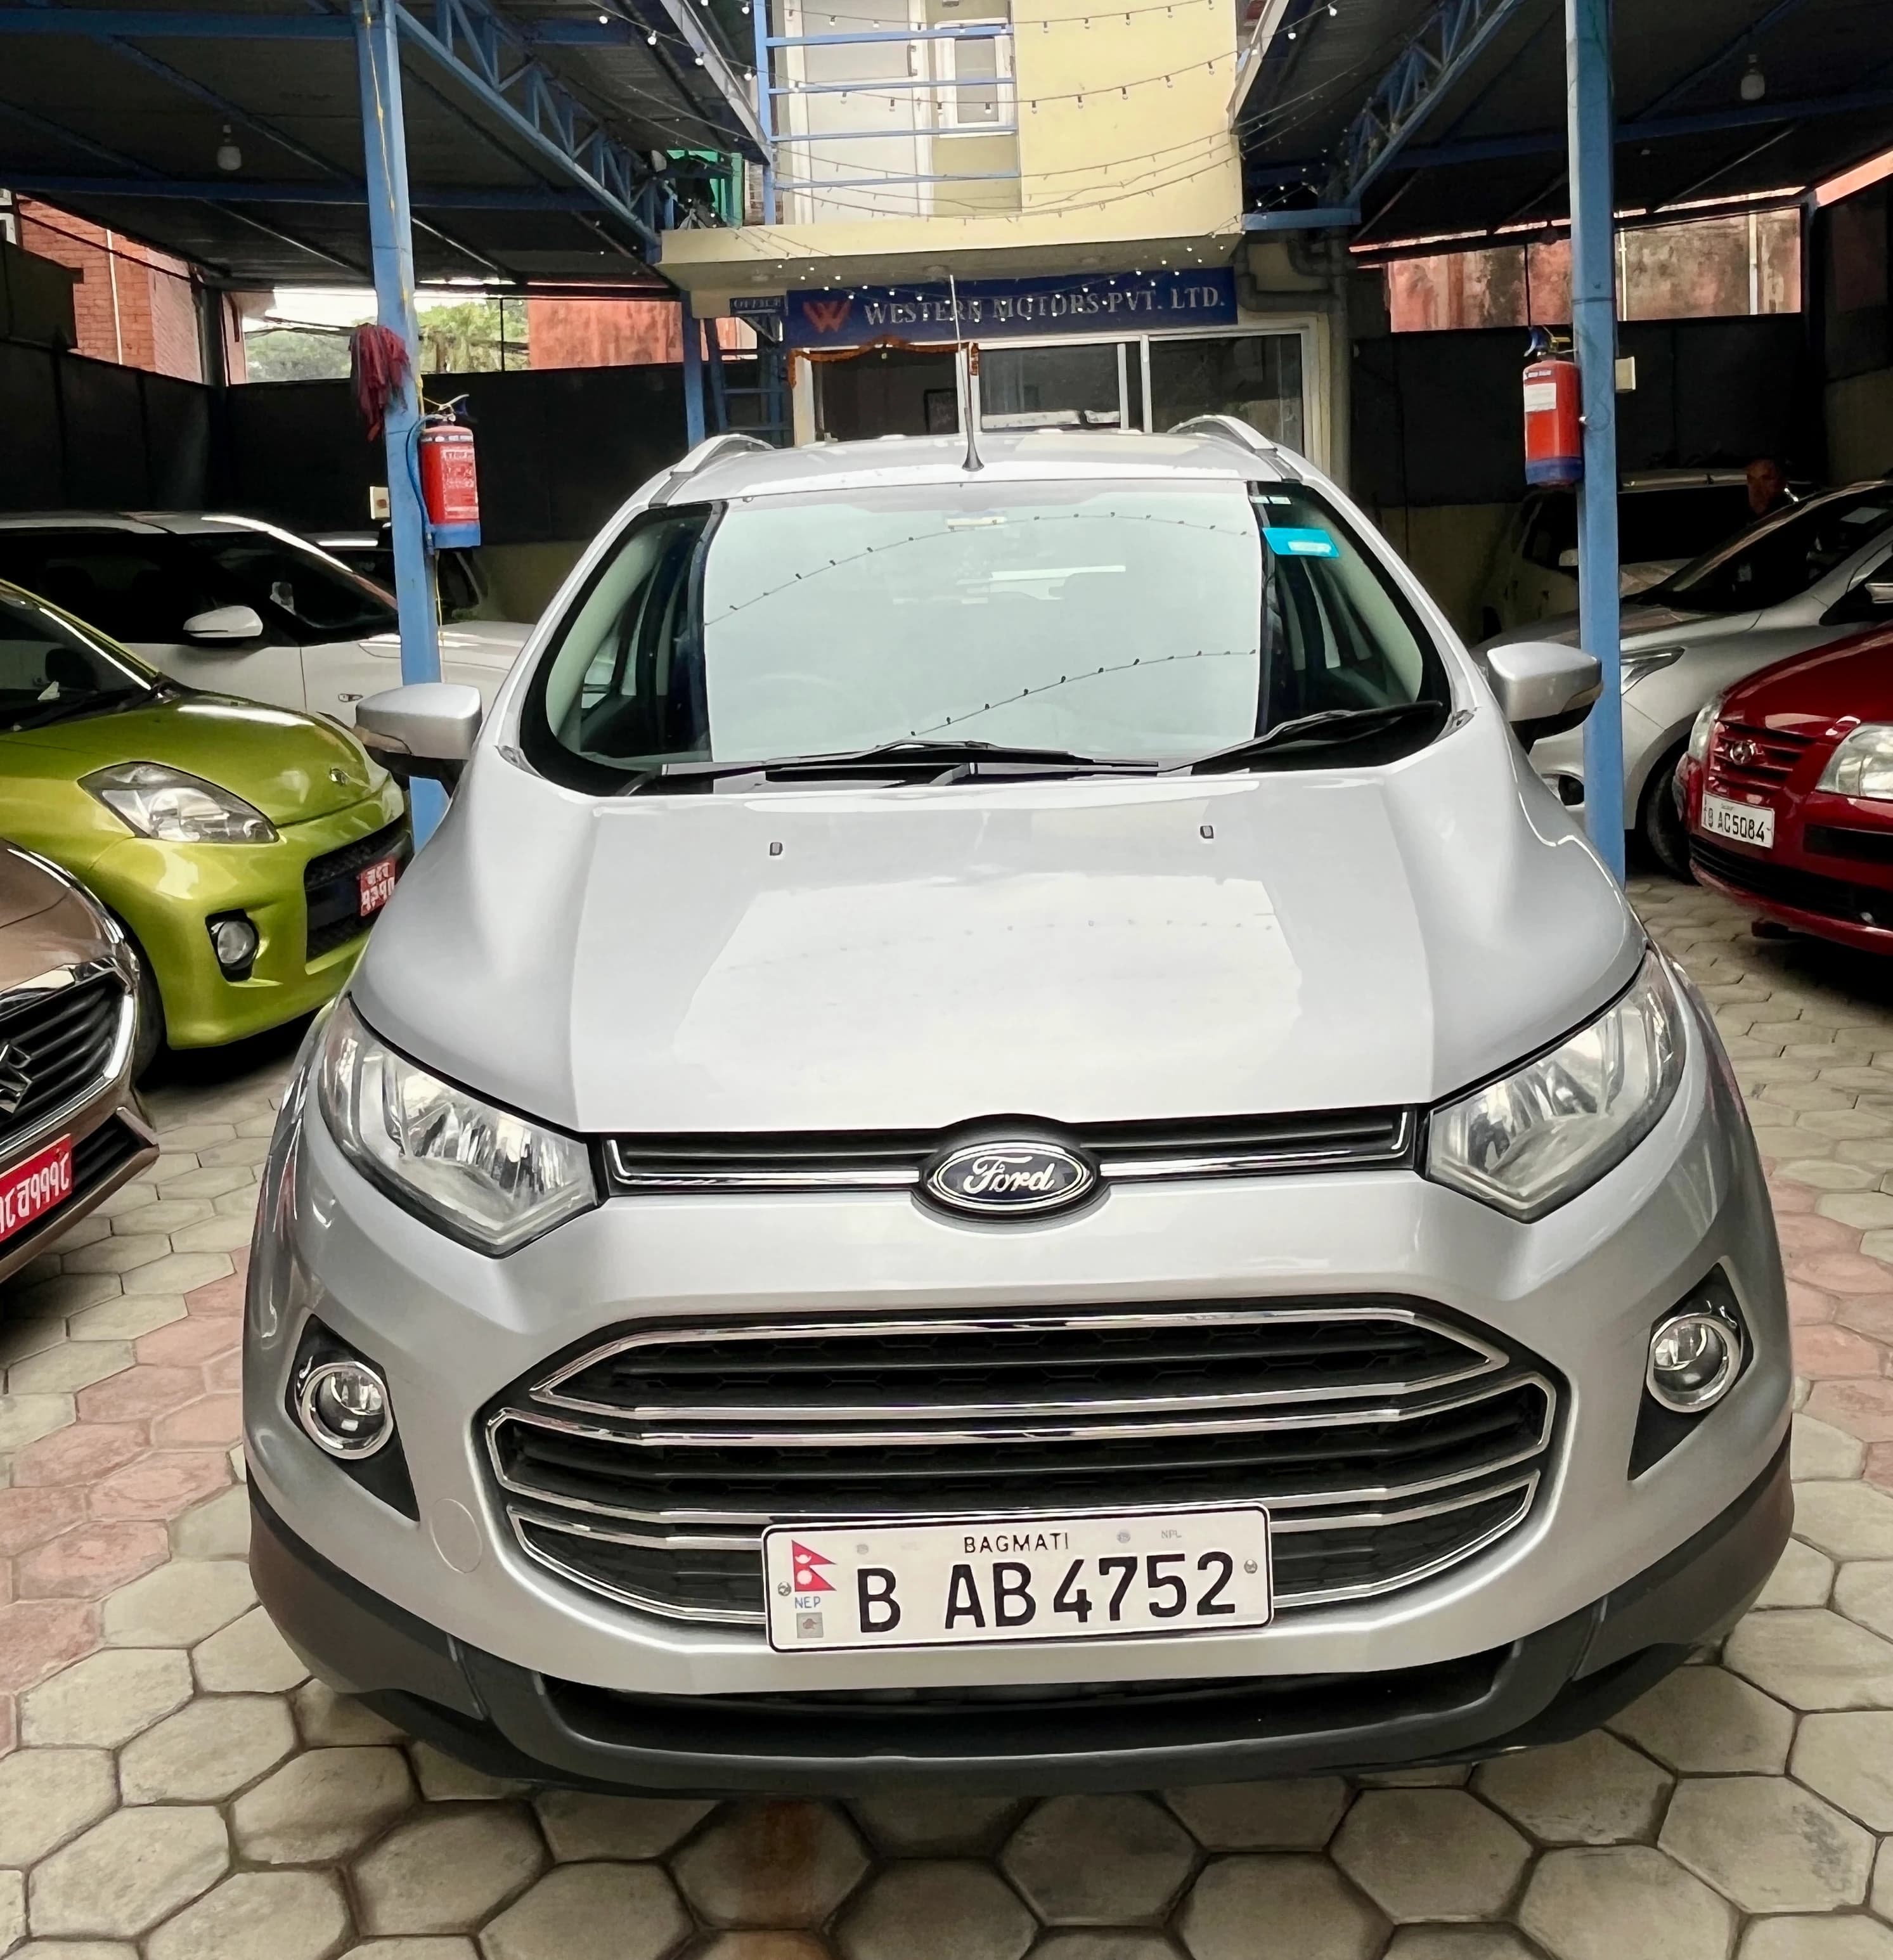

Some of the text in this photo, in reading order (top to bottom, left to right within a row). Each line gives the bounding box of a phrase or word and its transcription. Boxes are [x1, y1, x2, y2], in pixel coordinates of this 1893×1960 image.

[863, 299, 983, 325] WESTERN
[993, 292, 1099, 318] MOTORS
[1171, 287, 1226, 309] LTD.
[962, 1156, 1056, 1194] Ford
[964, 1531, 1069, 1554] BAGMATI
[794, 1596, 822, 1609] NEP
[856, 1567, 901, 1634] B
